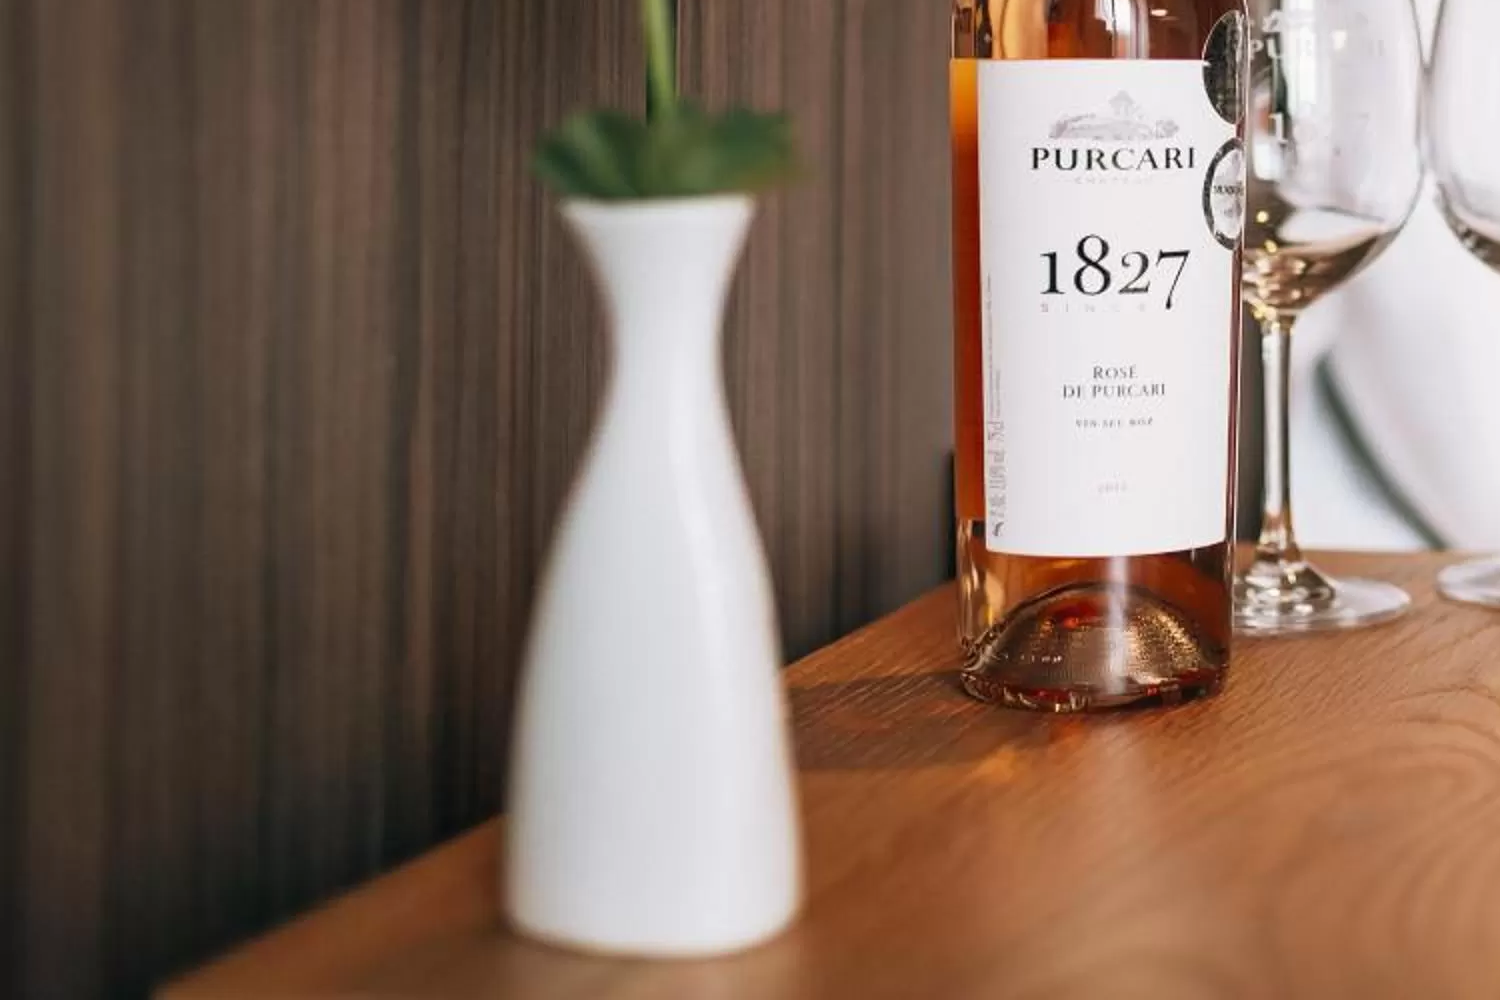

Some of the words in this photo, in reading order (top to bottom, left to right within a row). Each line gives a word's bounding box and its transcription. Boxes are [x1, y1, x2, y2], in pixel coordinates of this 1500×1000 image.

[1031, 147, 1195, 171] PURCARI
[1040, 234, 1191, 310] 1827
[1092, 382, 1165, 399] PURCARI
